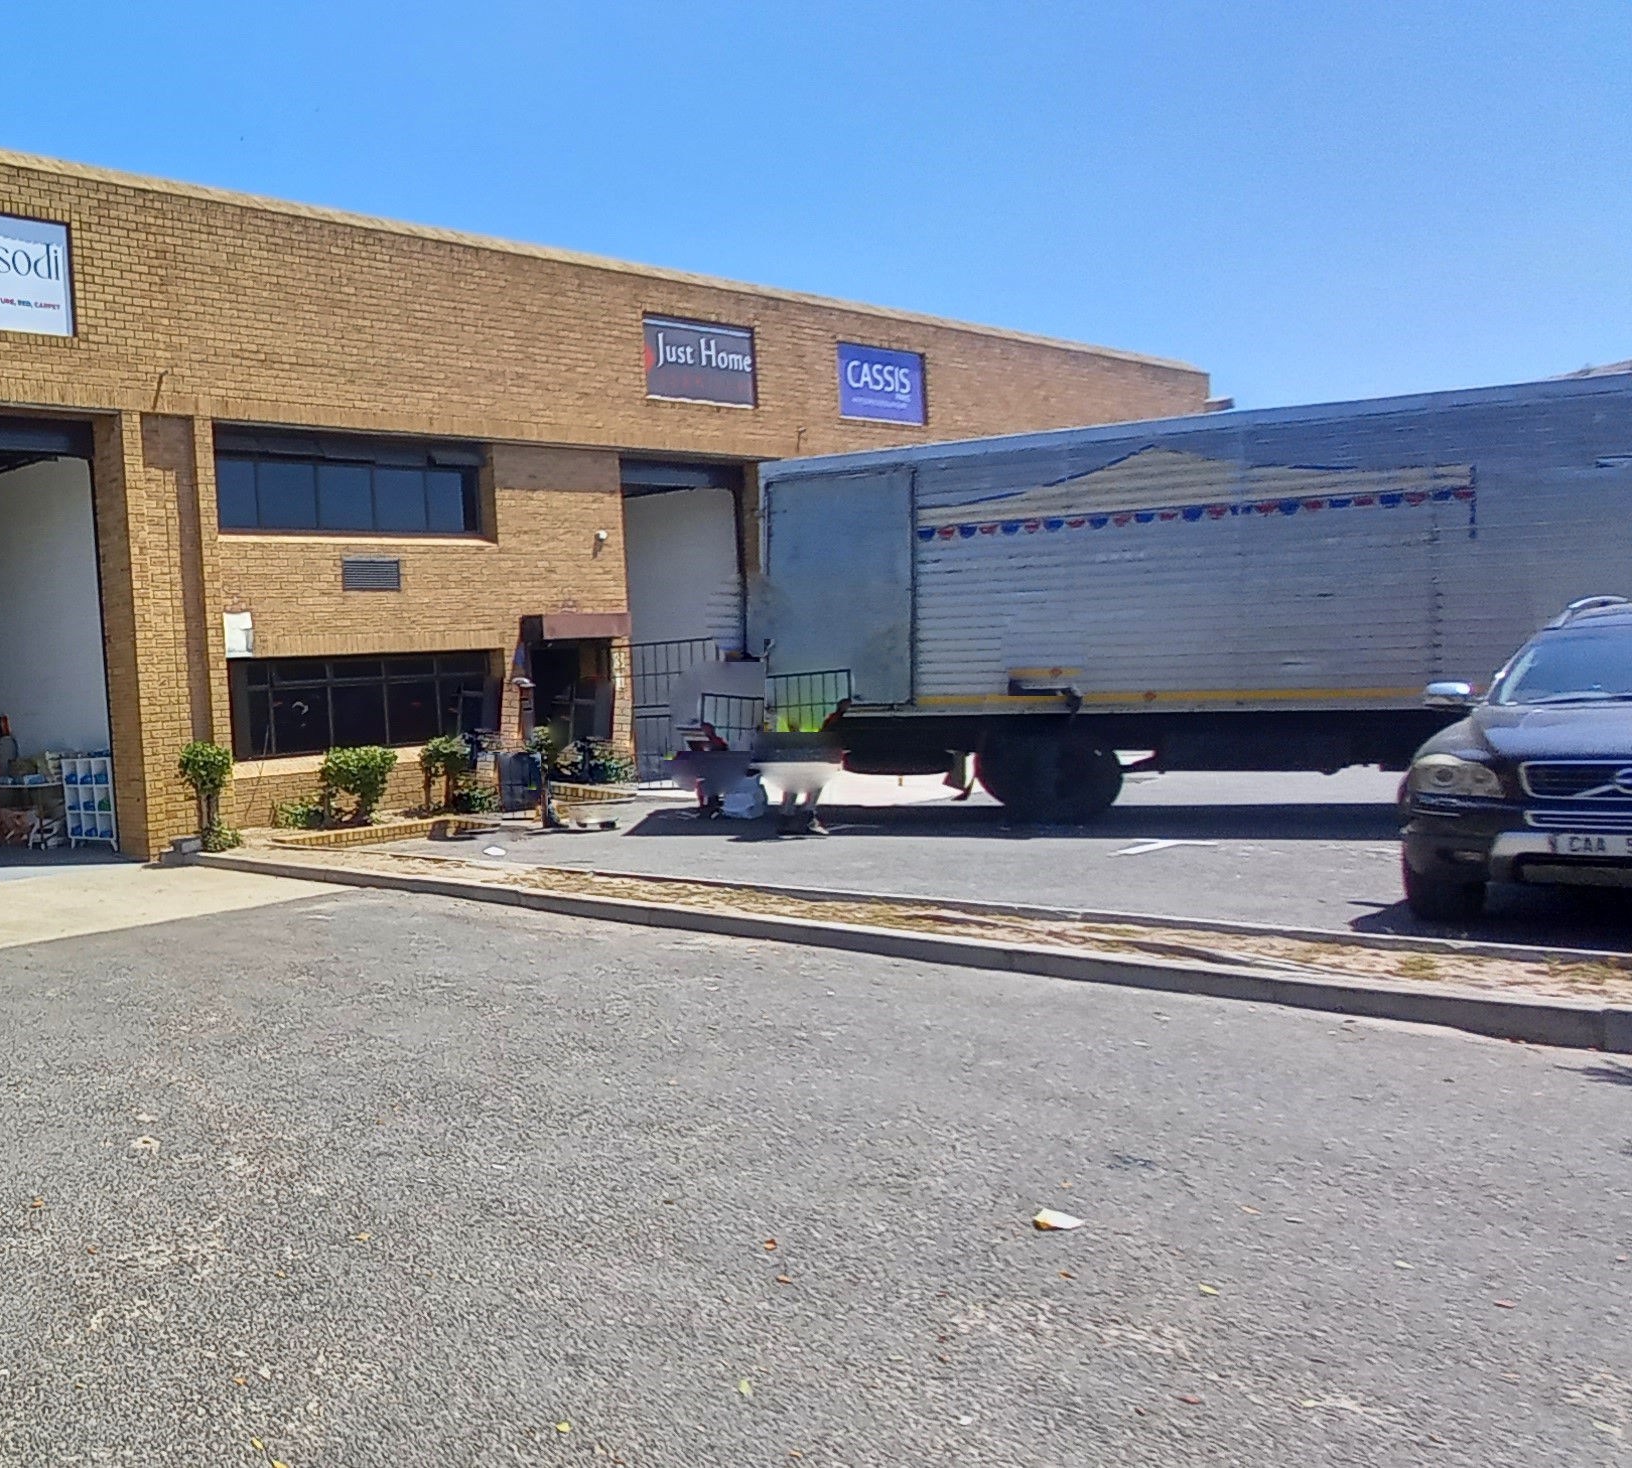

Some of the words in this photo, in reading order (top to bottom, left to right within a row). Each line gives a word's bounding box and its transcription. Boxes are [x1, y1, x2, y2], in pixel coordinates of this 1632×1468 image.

[34, 301, 60, 310] CARPET
[657, 332, 694, 368] Just
[700, 338, 752, 372] Home
[847, 360, 911, 394] CASSIS
